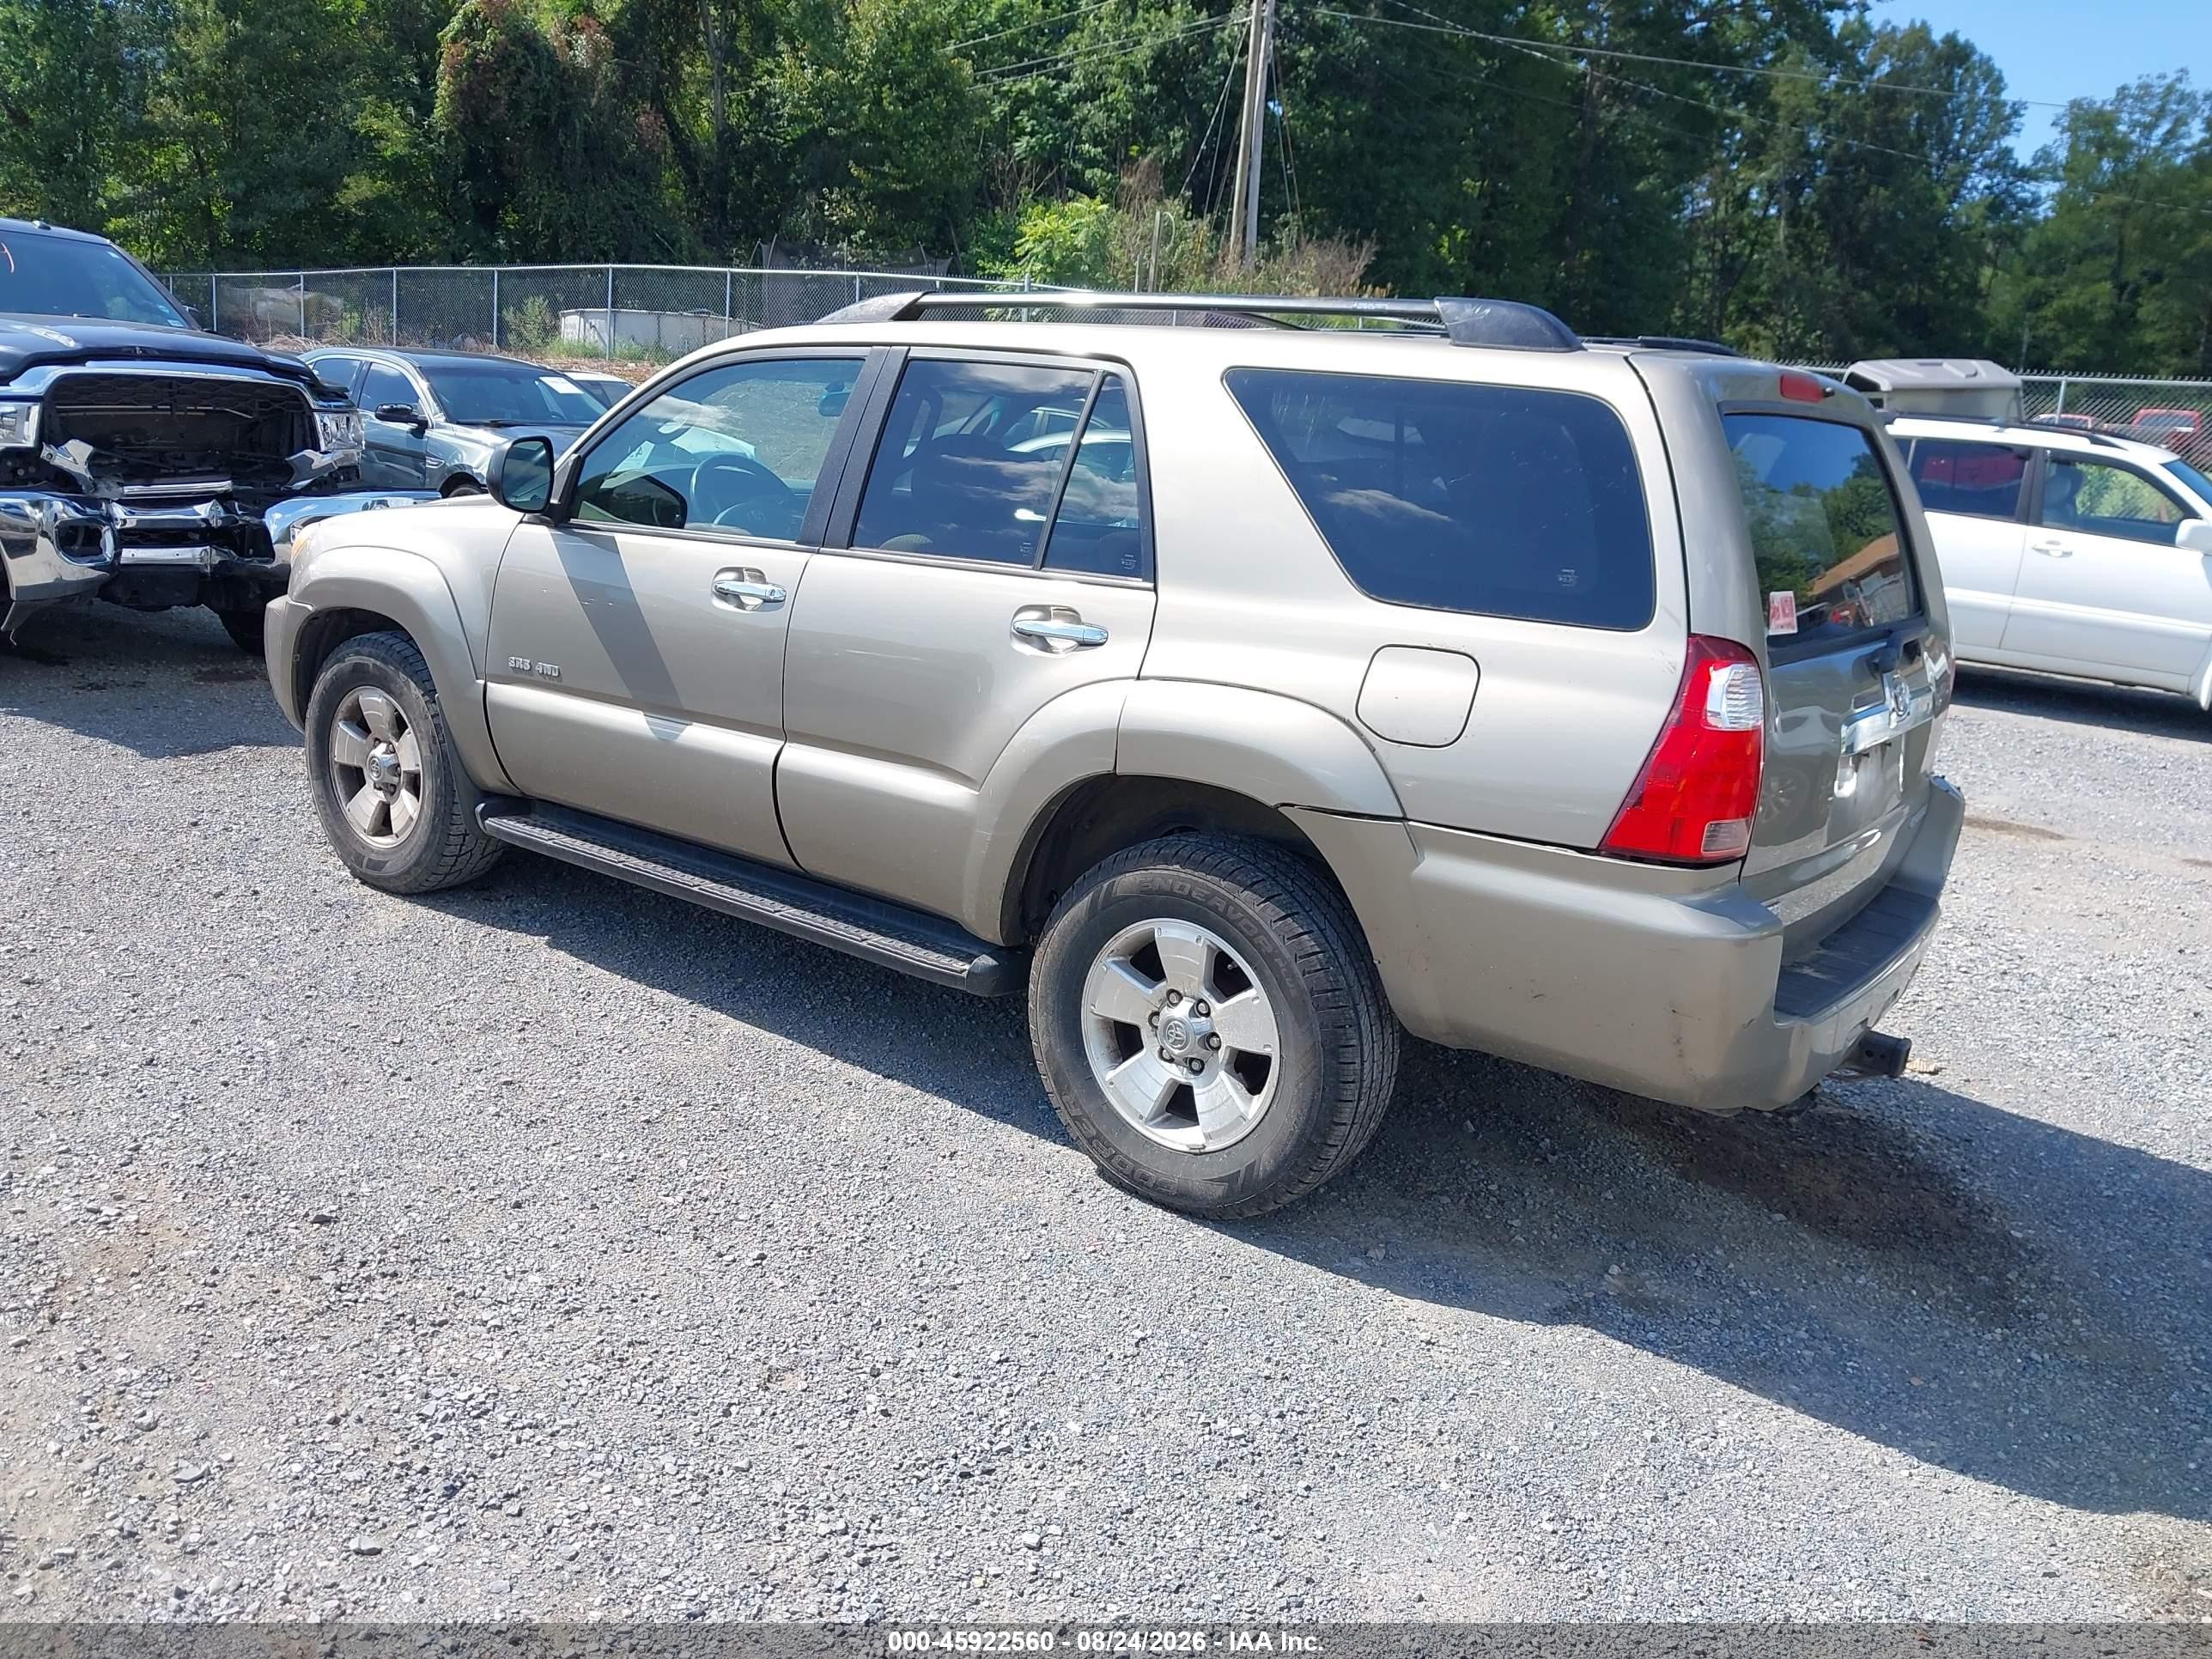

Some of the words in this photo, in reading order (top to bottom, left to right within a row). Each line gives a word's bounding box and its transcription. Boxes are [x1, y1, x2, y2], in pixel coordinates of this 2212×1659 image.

[534, 662, 560, 678] 4WD
[1139, 878, 1276, 953] ENDEAVOR
[1061, 1094, 1178, 1196] COOPER
